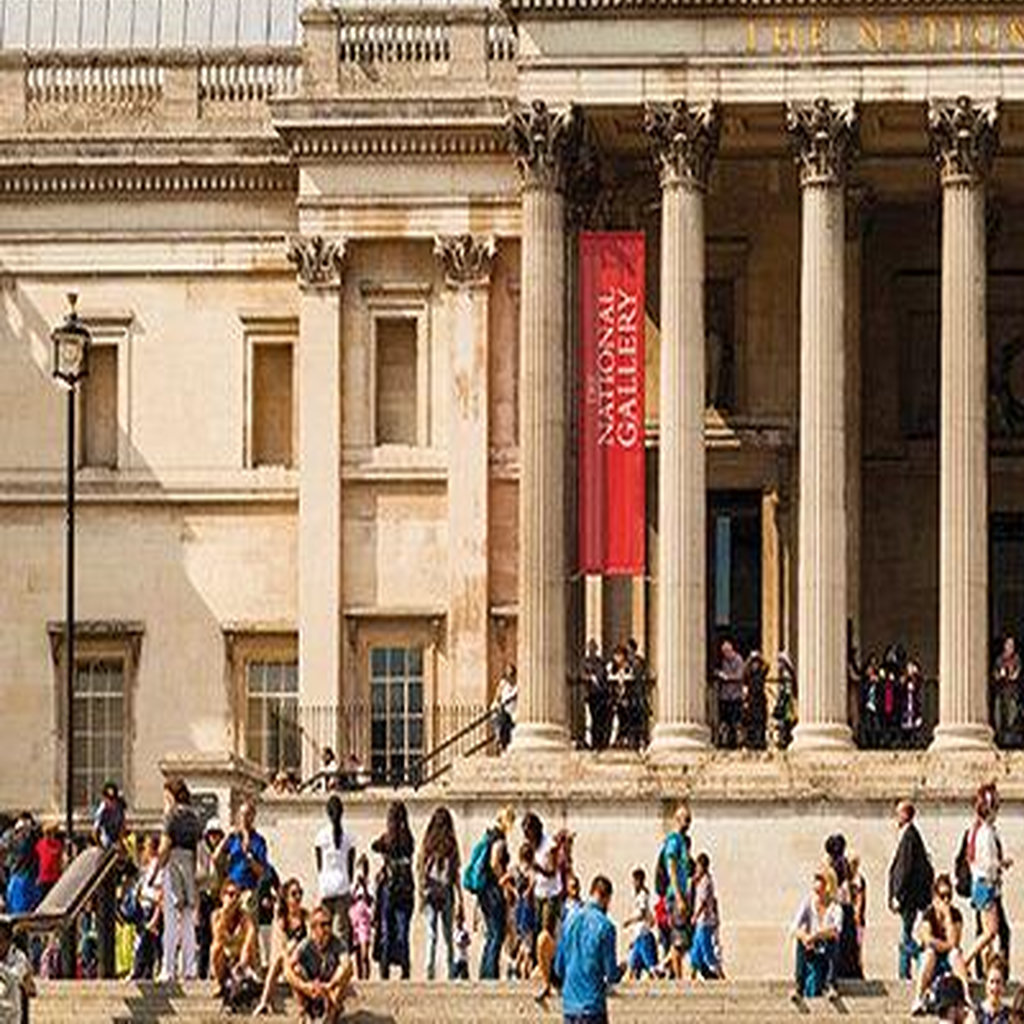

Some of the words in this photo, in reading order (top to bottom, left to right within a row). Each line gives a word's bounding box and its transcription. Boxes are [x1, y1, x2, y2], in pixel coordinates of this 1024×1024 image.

[742, 16, 828, 50] THE
[597, 285, 615, 447] NATIONAL
[616, 288, 638, 449] GALLERY
